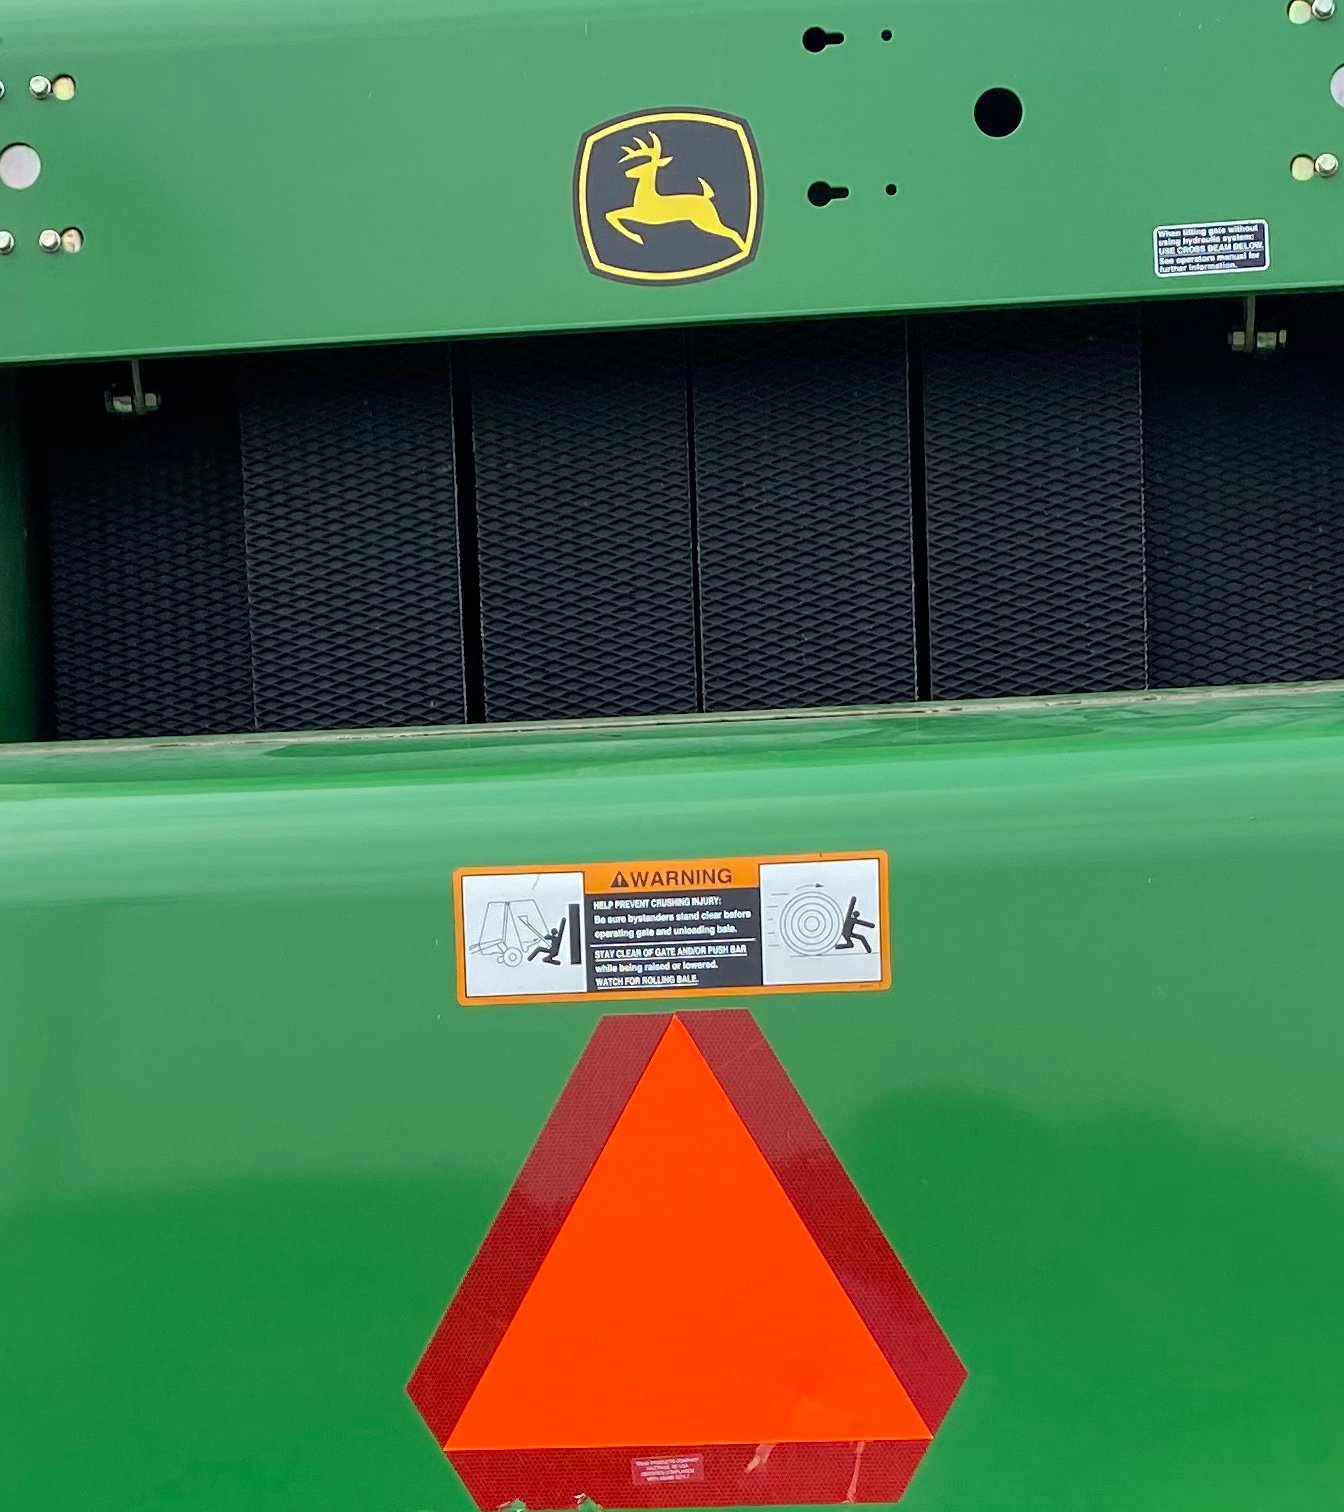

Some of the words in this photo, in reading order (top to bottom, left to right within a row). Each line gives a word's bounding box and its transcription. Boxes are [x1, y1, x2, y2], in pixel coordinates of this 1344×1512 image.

[1159, 247, 1175, 255] USE
[1177, 245, 1206, 254] CROSS
[1207, 243, 1231, 253] BEAM
[630, 868, 732, 888] WARNING
[593, 900, 614, 910] HELP
[614, 899, 650, 909] PREVENT
[650, 896, 690, 908] CRUSHING
[691, 895, 722, 906] INJURY:
[593, 915, 606, 924] Be
[607, 915, 627, 924] sure
[627, 913, 675, 925] bystanders
[676, 911, 700, 921] stand
[701, 910, 722, 920] clear
[723, 909, 752, 919] before
[594, 929, 635, 940] operating
[635, 928, 655, 939] gate
[655, 926, 672, 936] and
[673, 925, 716, 936] unloading
[716, 924, 738, 934] bale.
[594, 949, 615, 959] STAY
[616, 949, 642, 958] CLEAR
[642, 948, 654, 957] OF
[654, 947, 676, 957] GATE
[677, 946, 707, 956] AND/OR
[707, 945, 729, 955] PUSH
[729, 944, 747, 954] BAR
[595, 963, 618, 973] while
[618, 962, 643, 973] being
[644, 961, 671, 971] raised
[671, 962, 682, 971] or
[682, 960, 719, 970] lowered.
[595, 977, 624, 987] WATCH
[624, 976, 641, 986] FOR
[641, 975, 675, 985] ROLLING
[676, 974, 700, 984] BALE.
